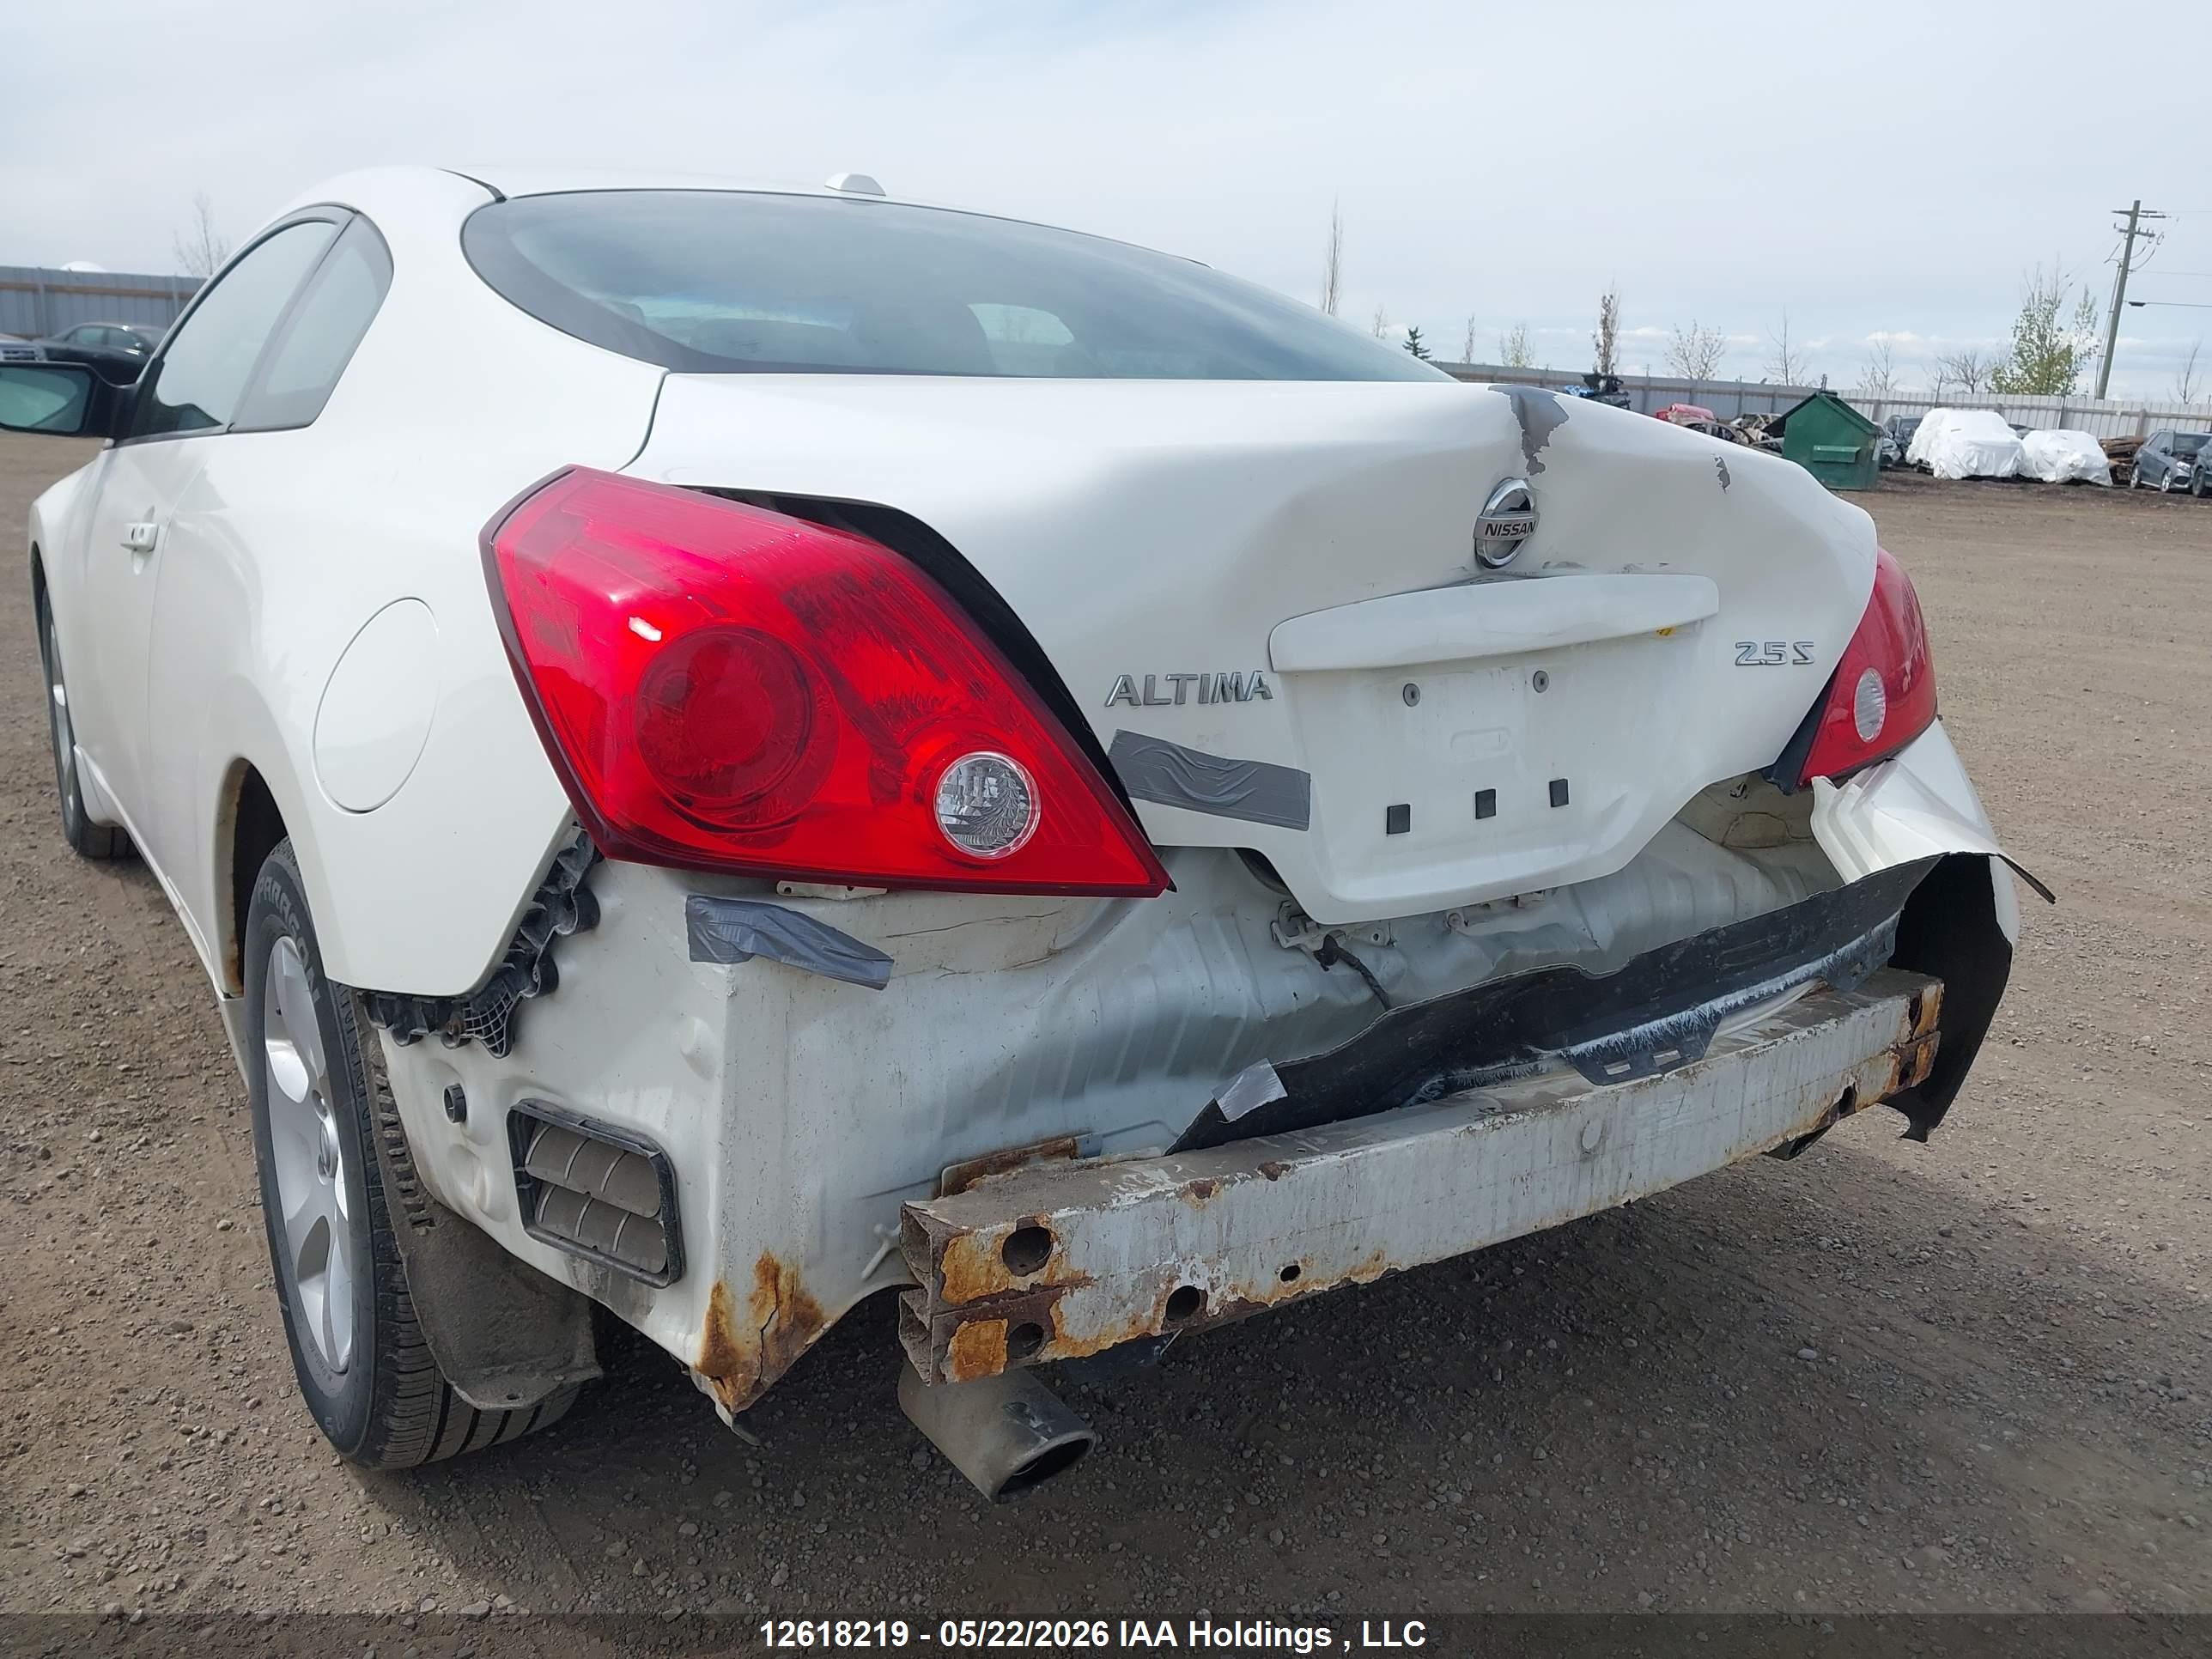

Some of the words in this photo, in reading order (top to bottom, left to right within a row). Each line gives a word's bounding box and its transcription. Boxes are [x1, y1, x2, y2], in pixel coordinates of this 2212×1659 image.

[1485, 521, 1536, 537] NISSAN
[1792, 641, 1814, 665] S
[1104, 670, 1273, 707] ALTIMA
